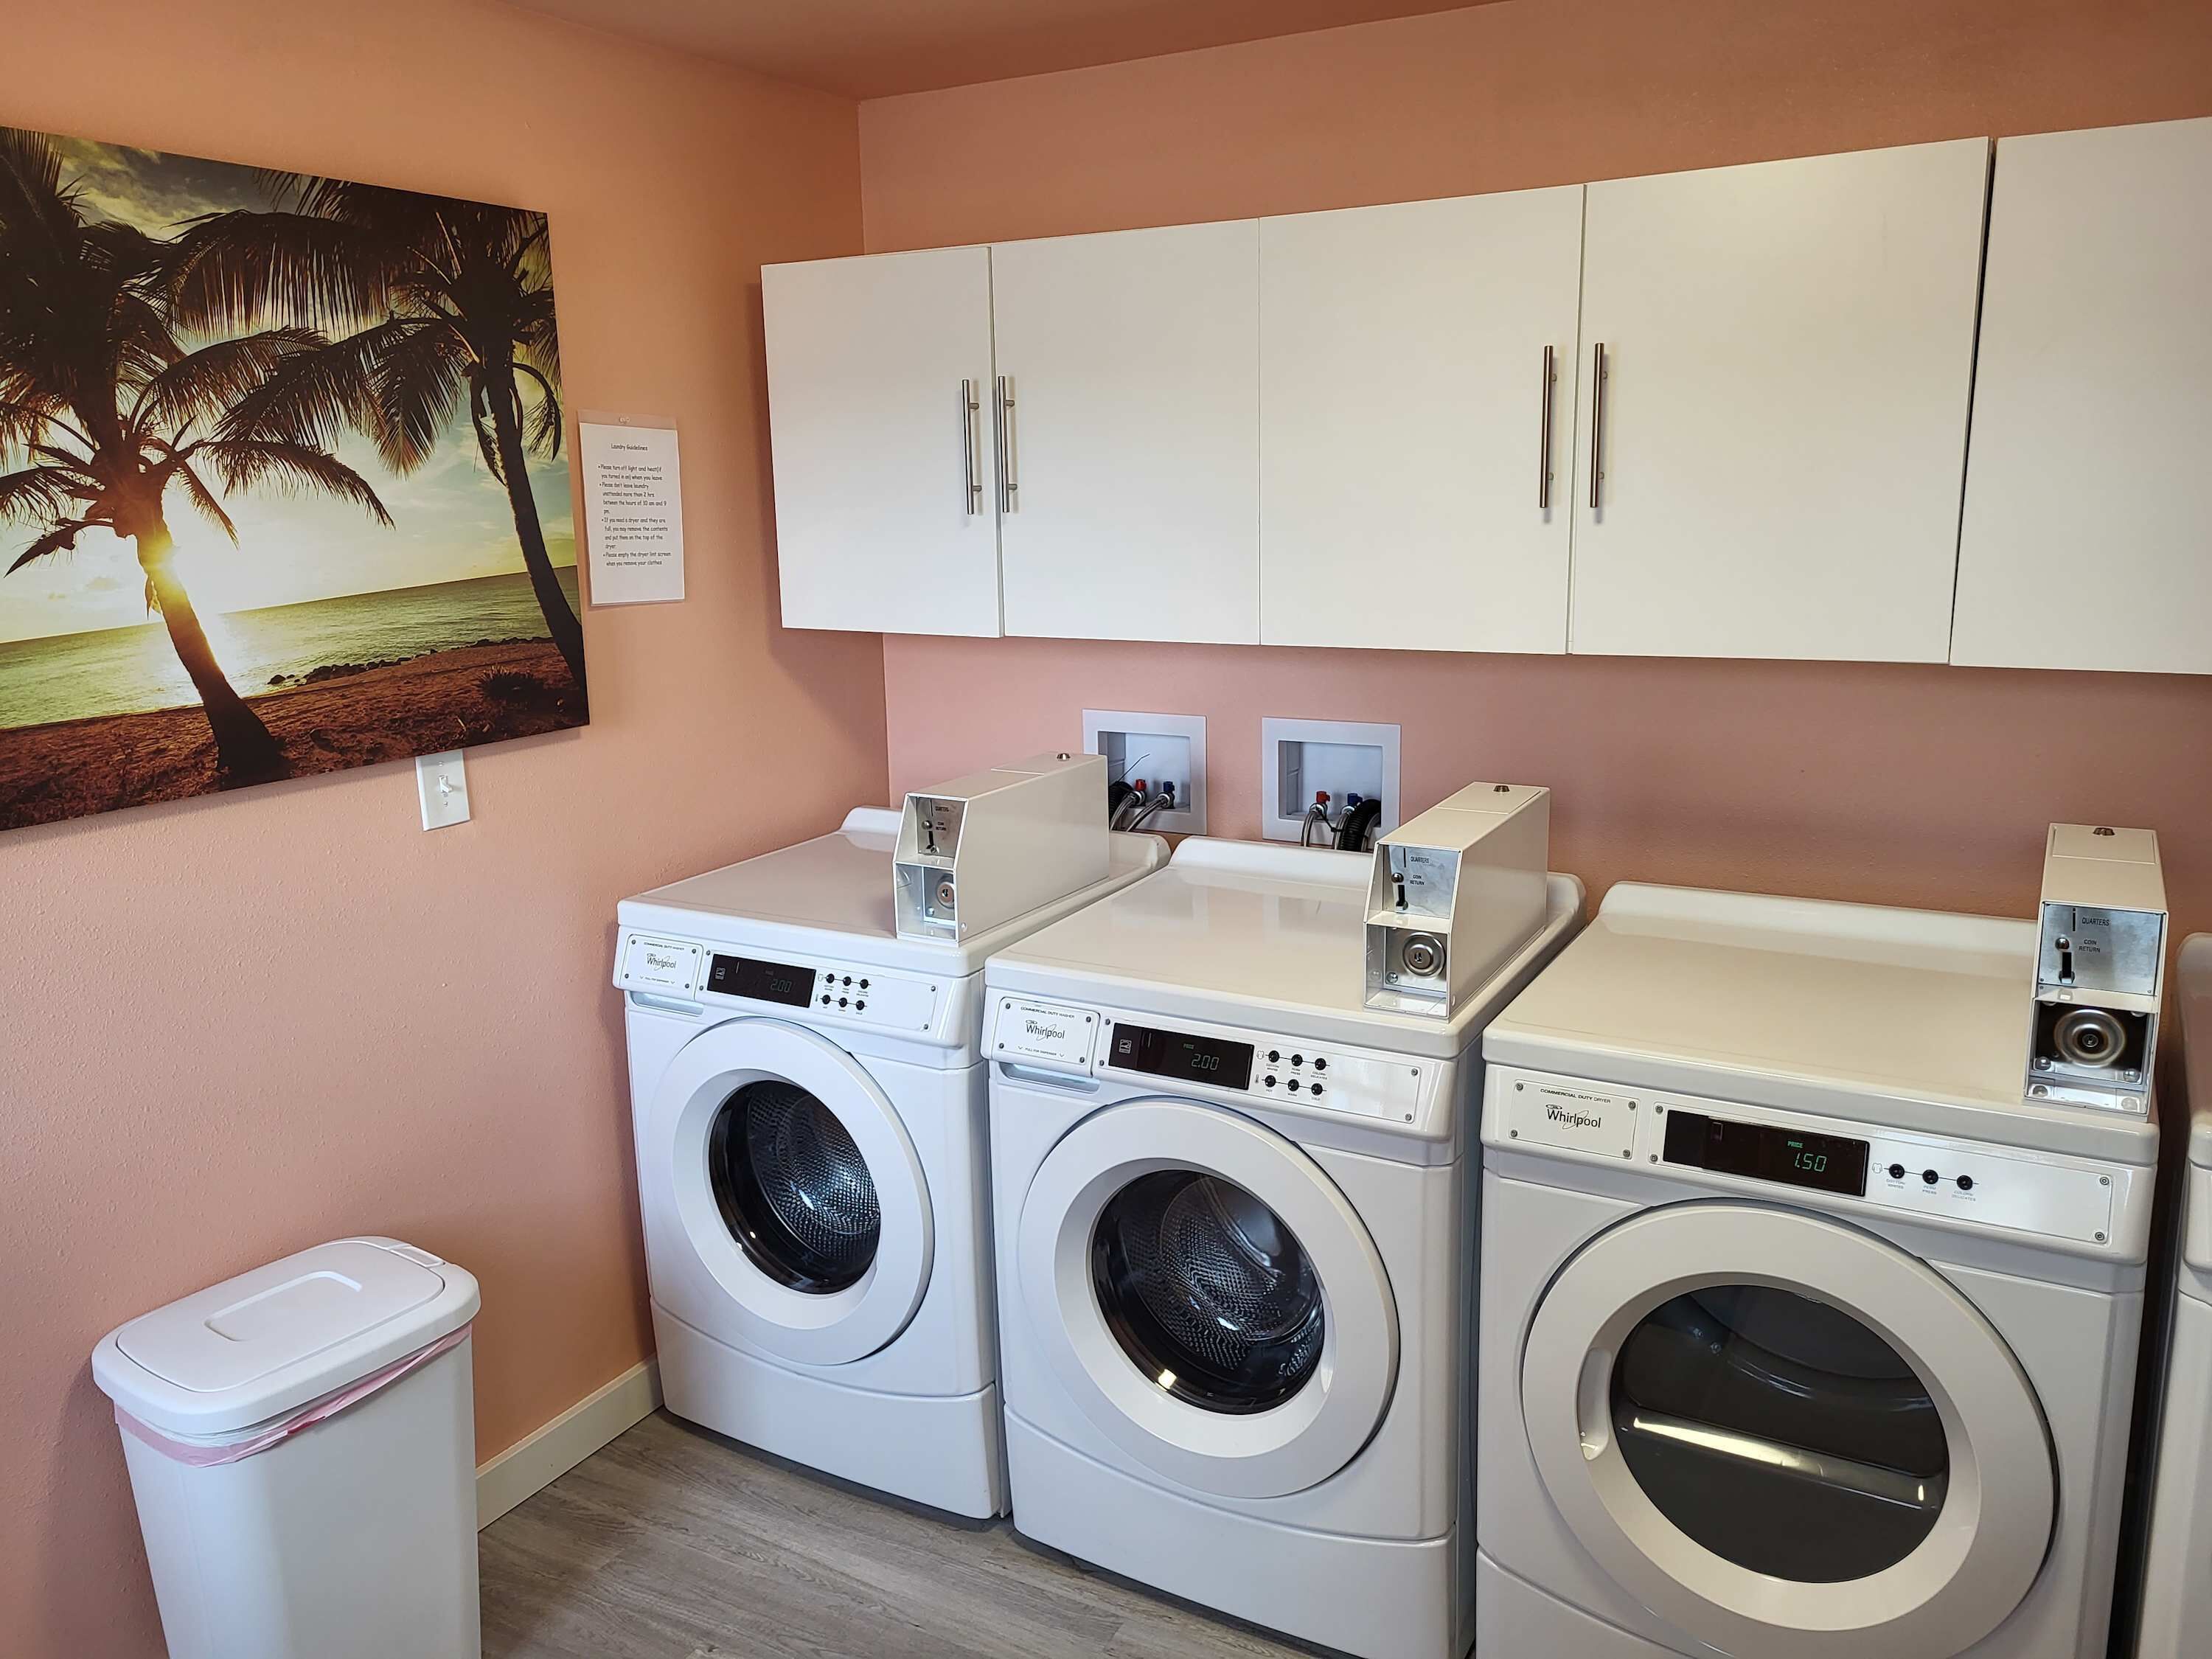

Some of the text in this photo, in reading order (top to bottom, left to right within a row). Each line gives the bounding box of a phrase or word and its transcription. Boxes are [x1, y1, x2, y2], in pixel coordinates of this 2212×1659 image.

[2082, 917, 2110, 926] QUARTERS
[647, 957, 676, 969] Whirlpool
[1026, 1023, 1065, 1039] Whirlpool
[1192, 1054, 1220, 1070] 2.00
[1540, 1089, 1576, 1098] COMMERCIAL
[1547, 1108, 1601, 1128] Whirlpool
[1795, 1152, 1827, 1172] 1.50
